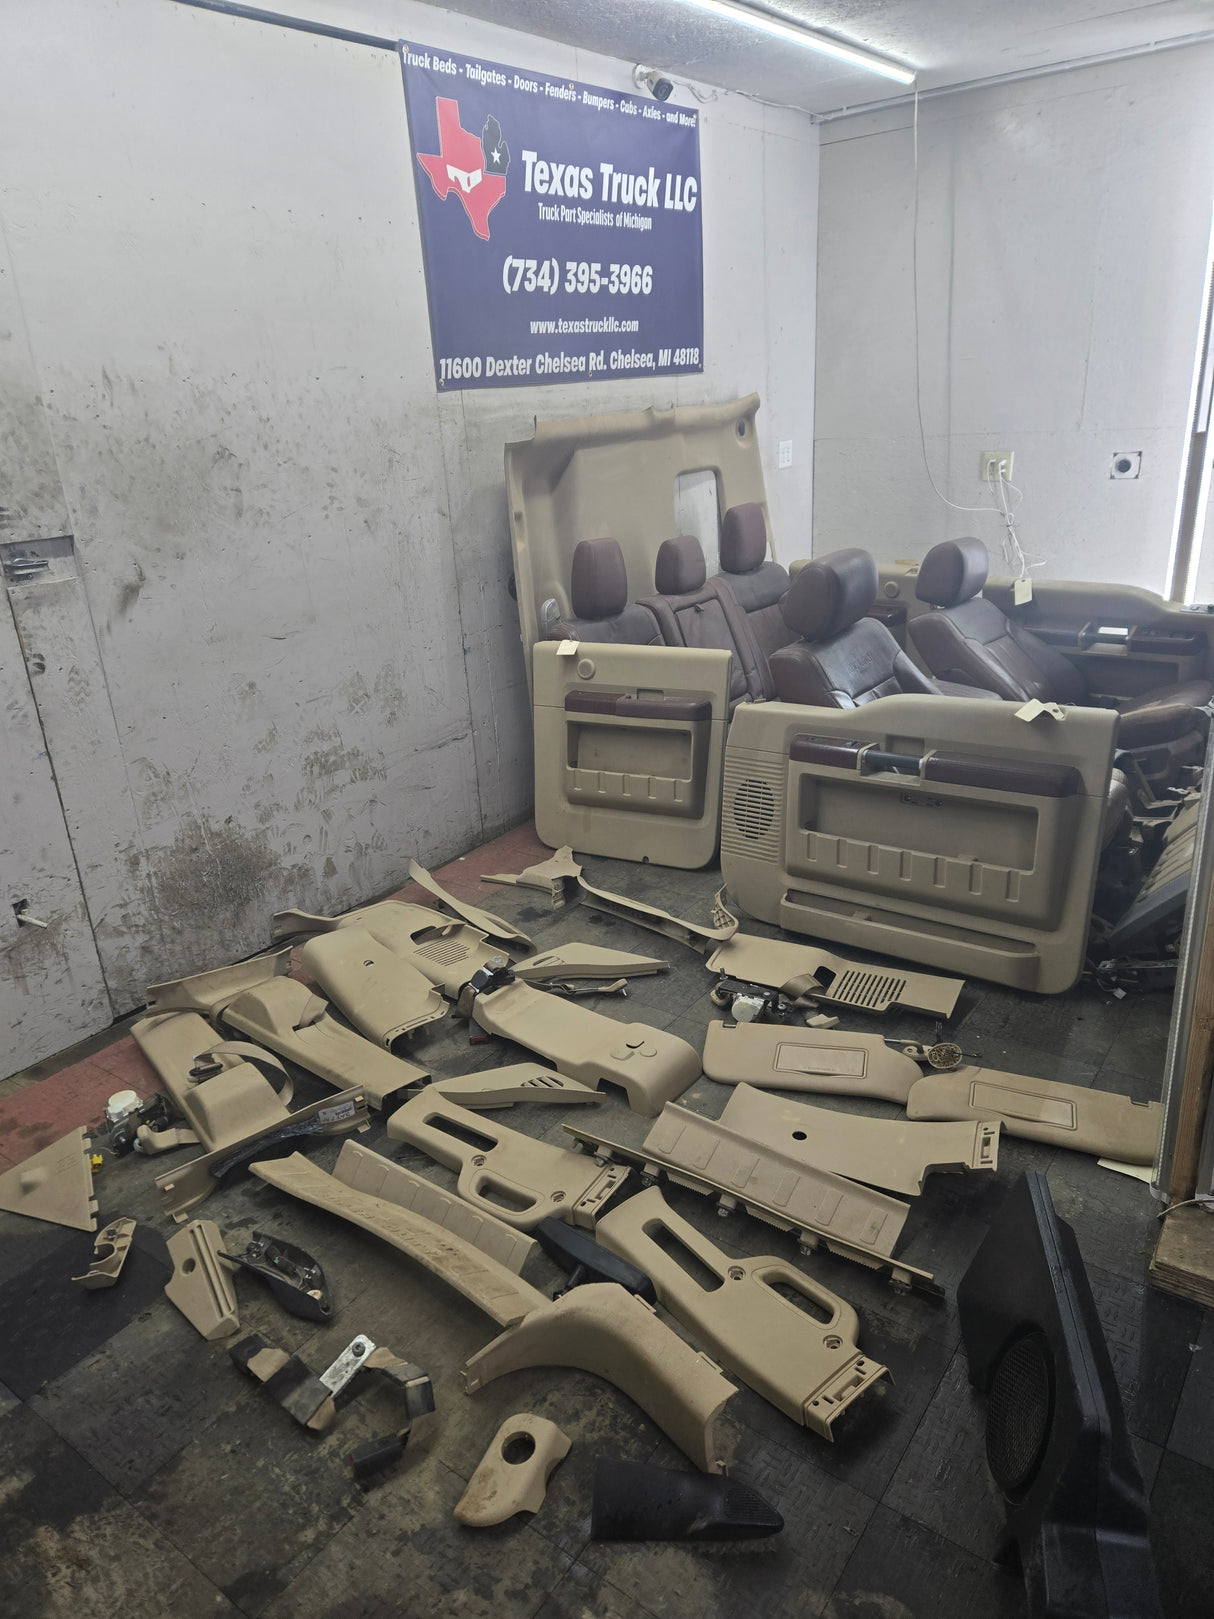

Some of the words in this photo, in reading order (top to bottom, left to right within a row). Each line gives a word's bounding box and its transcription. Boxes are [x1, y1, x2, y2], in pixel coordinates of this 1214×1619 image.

[403, 50, 430, 69] Truck
[433, 56, 457, 75] Beds
[465, 63, 506, 86] Tailgates
[514, 75, 538, 93] Doors
[545, 82, 576, 101] Fenders
[583, 91, 614, 110] Bumpers
[620, 100, 637, 115] Cabs
[643, 105, 661, 120] Axles
[666, 111, 679, 124] and
[522, 150, 593, 199] Texas
[600, 162, 659, 208] Truck
[664, 173, 698, 212] LLC
[538, 203, 560, 221] Truck
[560, 206, 576, 223] Part
[577, 207, 614, 228] Specialists
[616, 212, 623, 227] of
[623, 212, 652, 232] Michigan
[502, 255, 559, 295] (734)
[564, 261, 653, 295] 395-3966
[530, 316, 639, 334] www.texastruckllc.com
[439, 356, 482, 379] 11600
[486, 354, 531, 377] Dexter
[535, 351, 586, 374] Chelsea
[588, 351, 607, 371] Rd.
[609, 349, 656, 370] Chelsea,
[658, 348, 671, 367] MI
[673, 347, 699, 365] 48118
